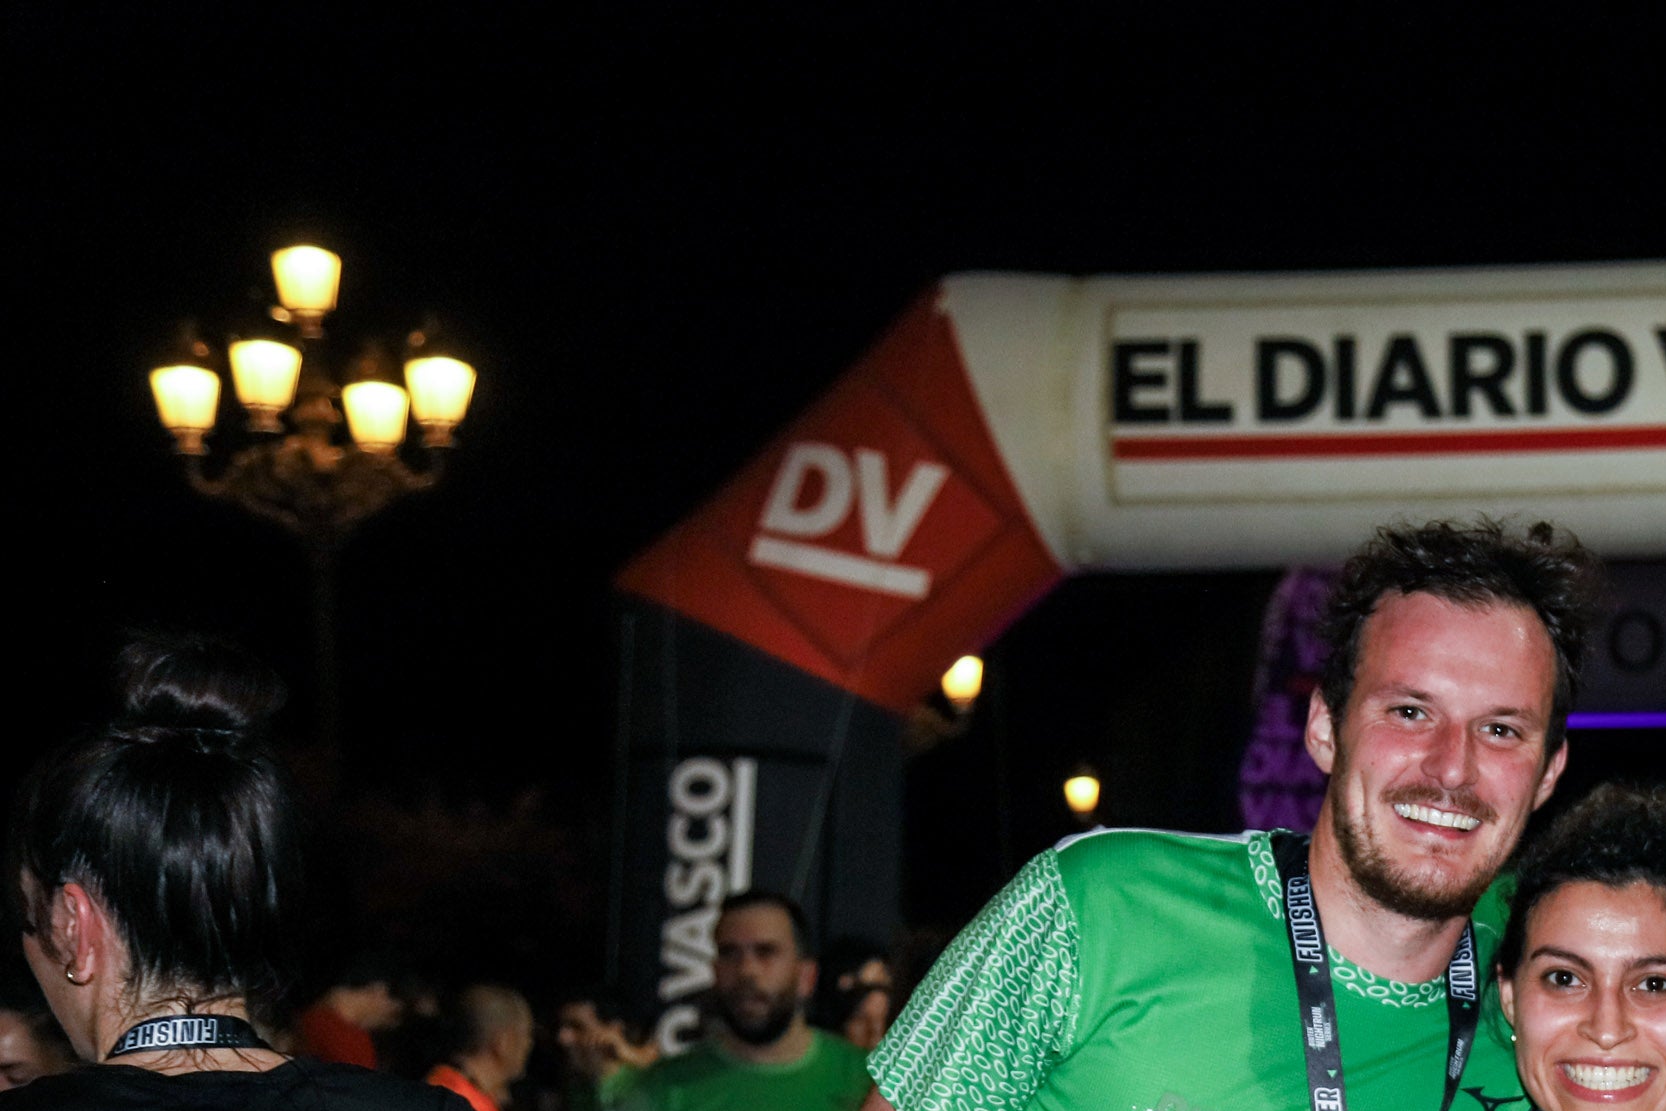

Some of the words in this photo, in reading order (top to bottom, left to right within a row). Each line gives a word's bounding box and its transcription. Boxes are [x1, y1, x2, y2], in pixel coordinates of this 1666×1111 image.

[1112, 338, 1232, 424] EL
[1254, 327, 1638, 423] DIARIO
[760, 440, 950, 559] DV
[658, 756, 732, 1002] VASCO
[1287, 875, 1323, 963] FINISHER
[116, 1018, 218, 1053] FINISHE
